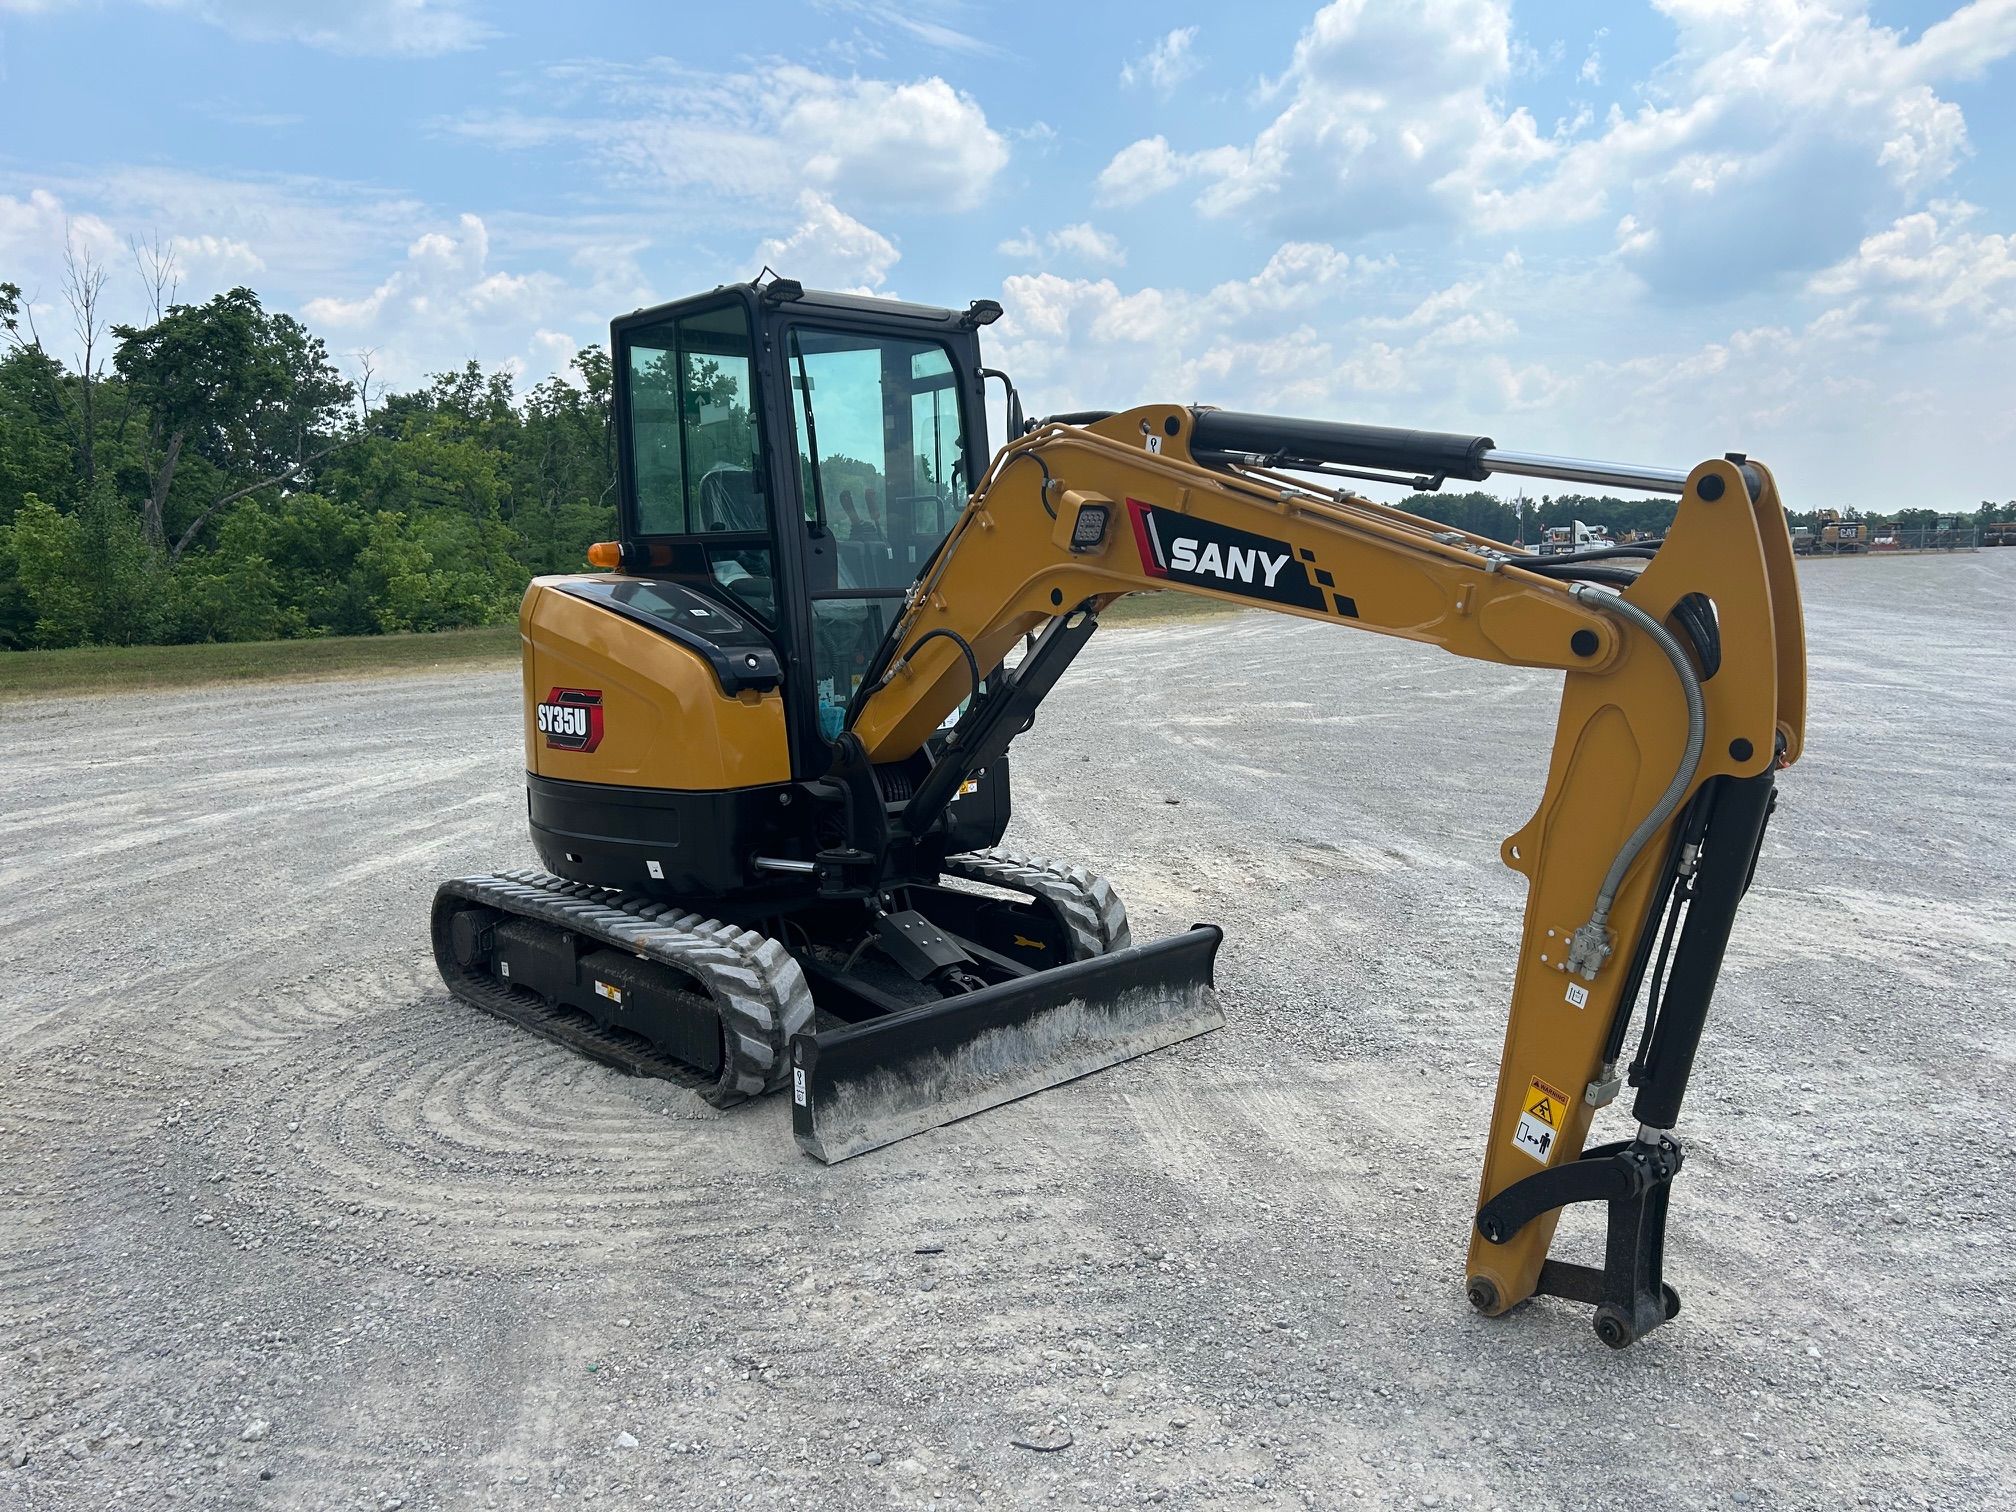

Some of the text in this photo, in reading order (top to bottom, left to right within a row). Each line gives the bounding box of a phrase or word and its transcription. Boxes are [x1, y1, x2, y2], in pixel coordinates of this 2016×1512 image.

[1840, 528, 1857, 538] CAT
[1170, 537, 1290, 588] SANY
[537, 704, 587, 736] SY35U
[1539, 1083, 1566, 1103] WARNING
